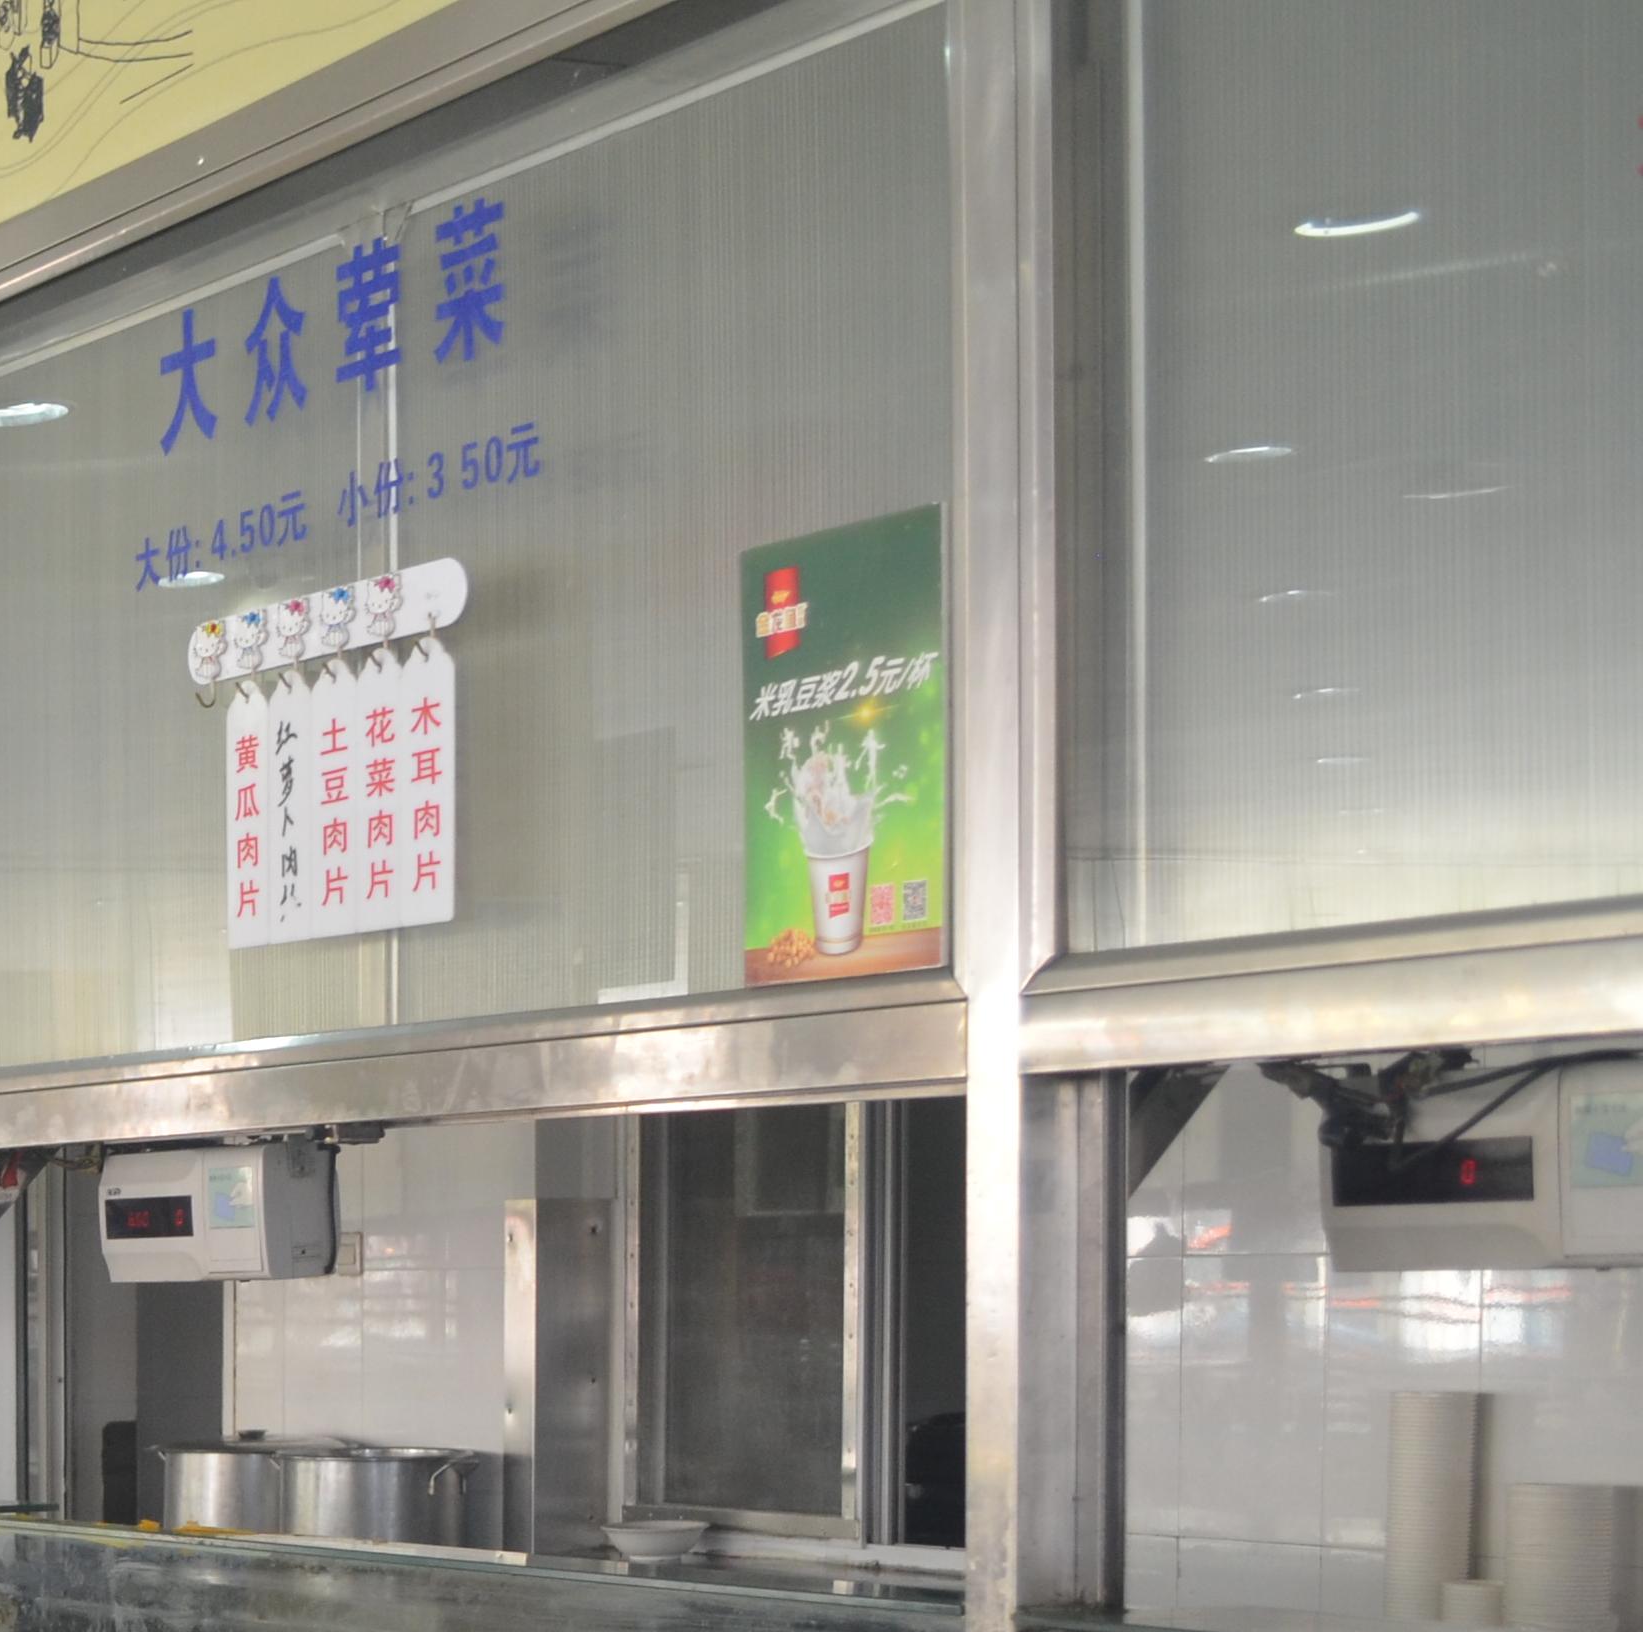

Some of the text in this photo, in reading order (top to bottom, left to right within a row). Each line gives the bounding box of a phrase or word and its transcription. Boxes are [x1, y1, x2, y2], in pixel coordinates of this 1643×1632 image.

[160, 198, 505, 456] 大众荤菜
[235, 735, 260, 918] 黄瓜肉片
[320, 718, 349, 906] 土豆肉片
[365, 707, 396, 900] 花菜肉片
[411, 697, 443, 892] 木耳肉片
